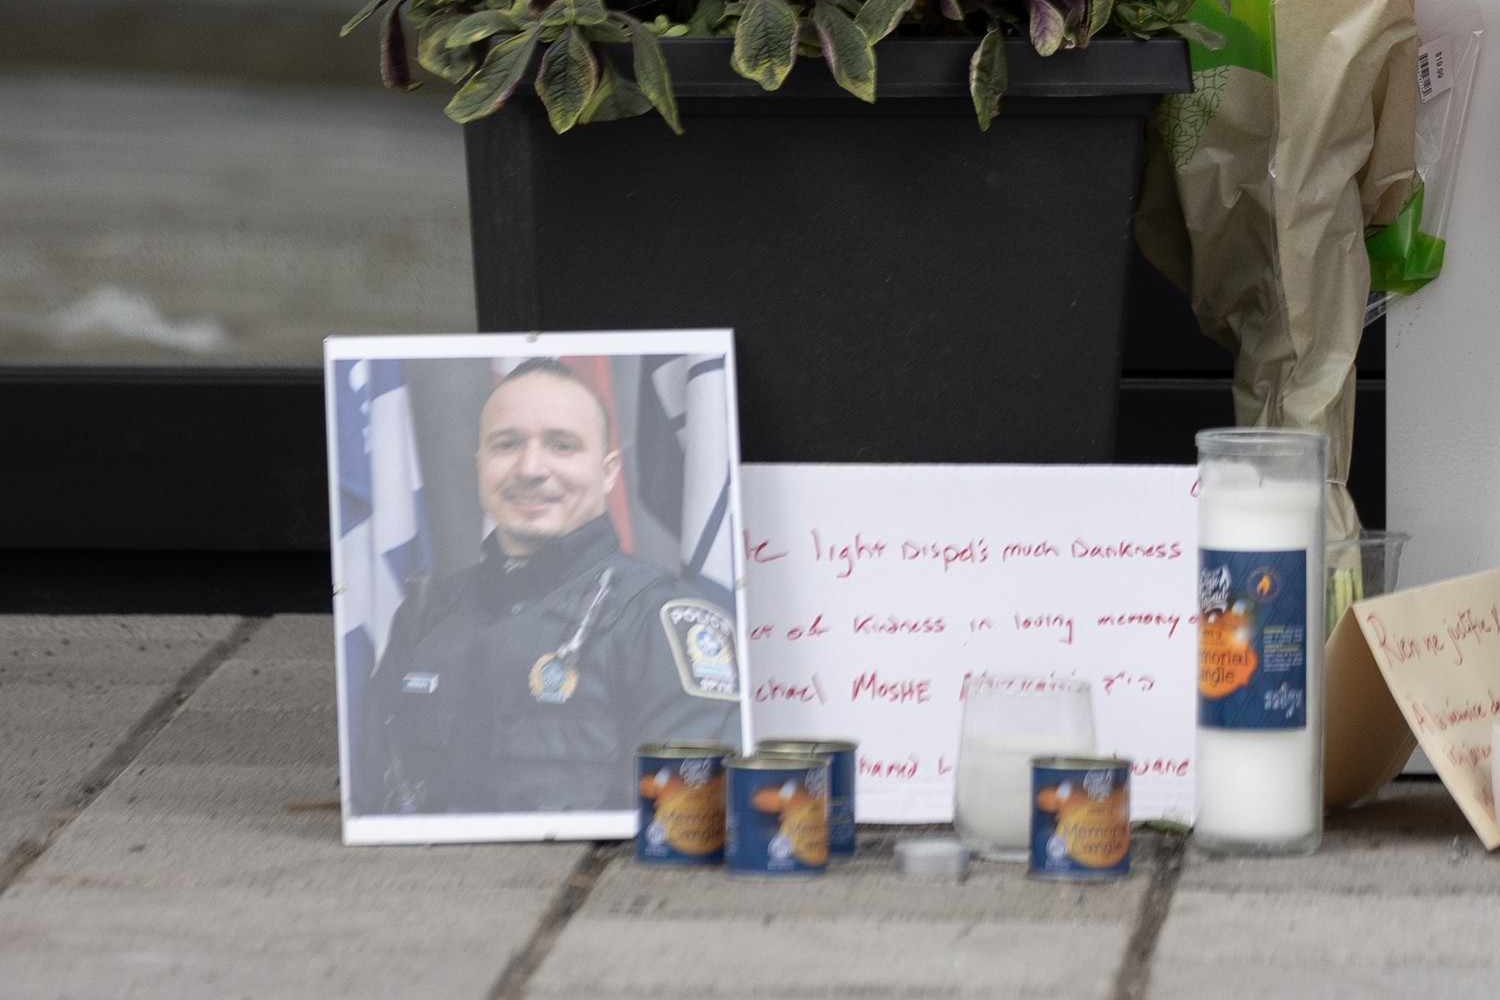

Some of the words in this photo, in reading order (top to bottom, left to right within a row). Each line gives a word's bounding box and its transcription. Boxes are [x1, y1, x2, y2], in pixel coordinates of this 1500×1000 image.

[1014, 612, 1074, 645] loving
[1367, 611, 1420, 668] Rien
[1422, 633, 1445, 656] ne
[755, 672, 827, 705] chael
